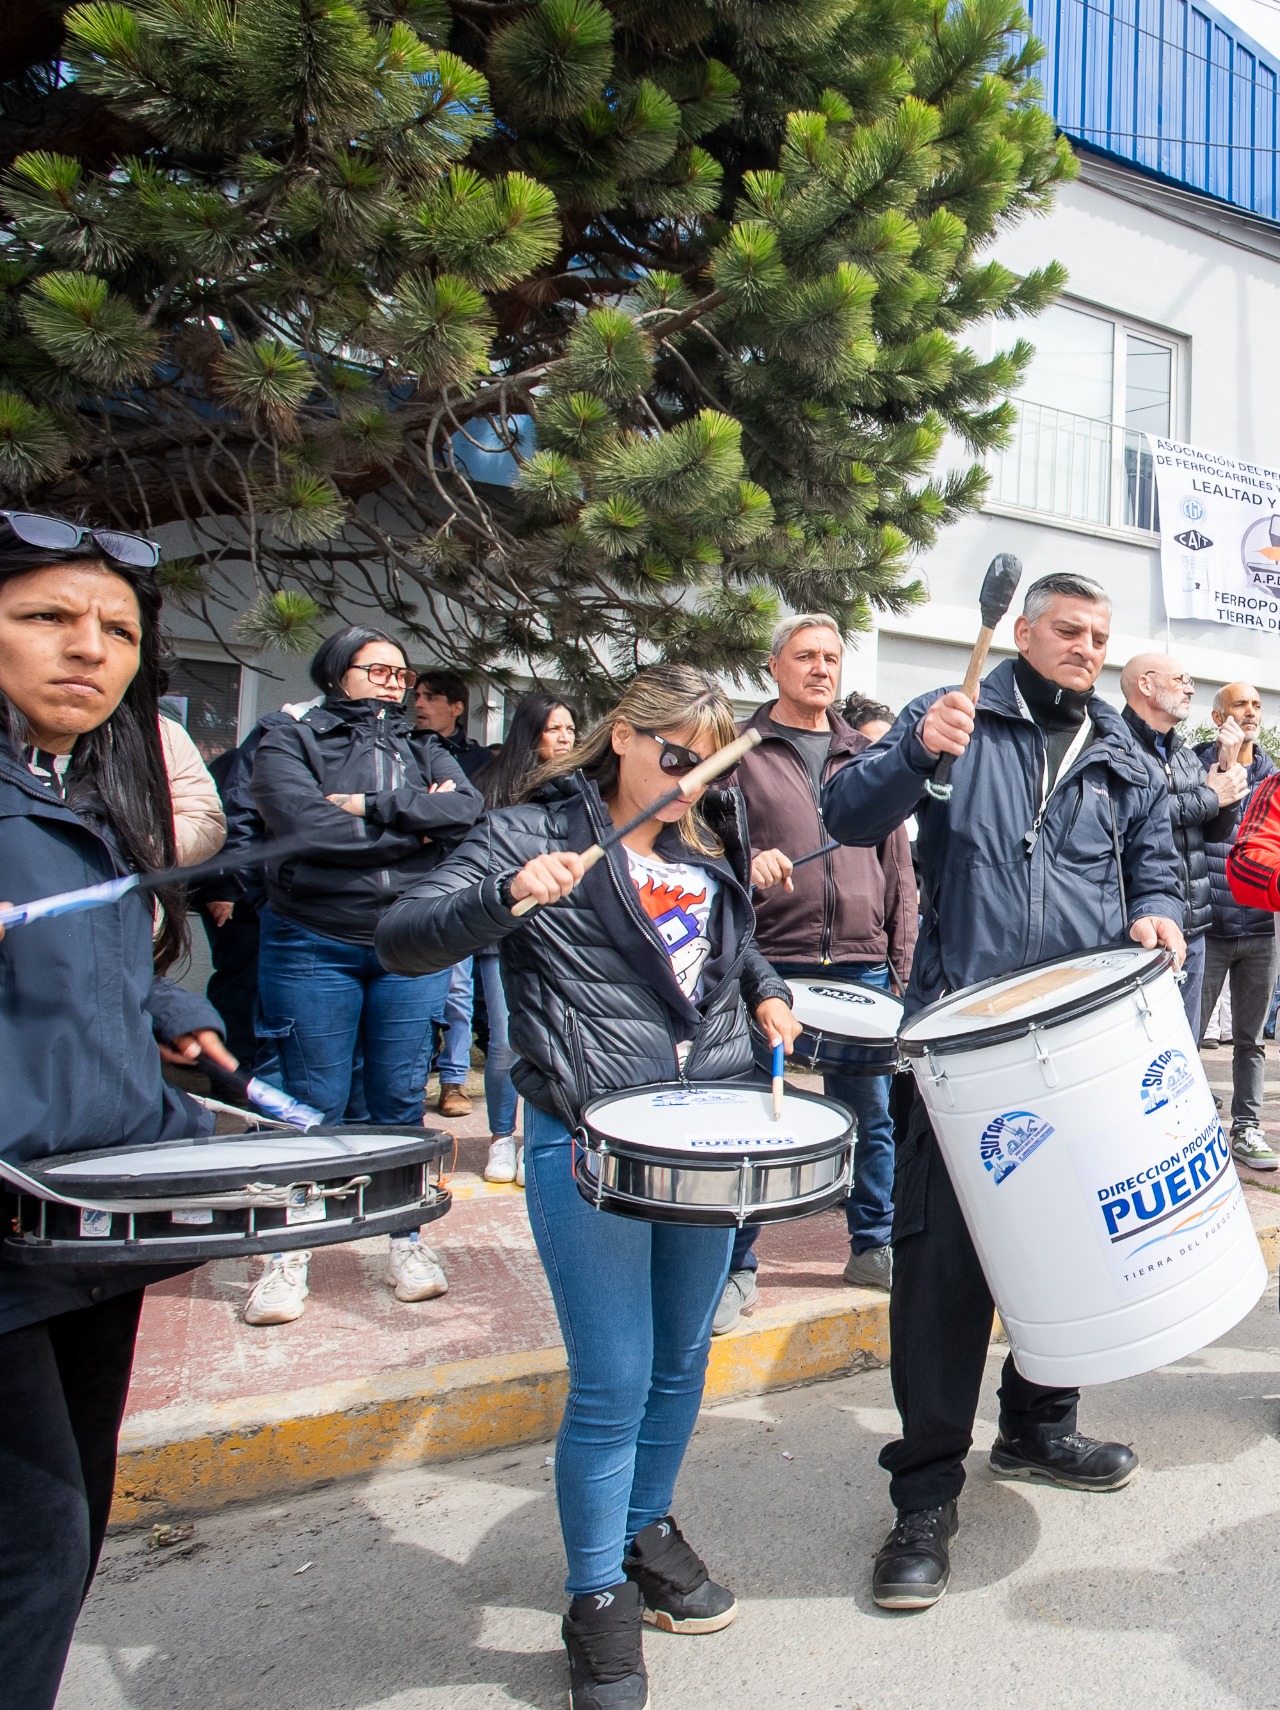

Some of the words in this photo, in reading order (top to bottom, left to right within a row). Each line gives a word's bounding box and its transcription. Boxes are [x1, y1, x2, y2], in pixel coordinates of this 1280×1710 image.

[1157, 439, 1235, 469] ASOCIACIÓN
[1238, 462, 1261, 476] DEL
[1157, 455, 1173, 466] DE
[1175, 458, 1273, 491] FERROCARRILES
[1192, 478, 1263, 506] LEALTAD
[1267, 496, 1276, 509] Y
[1216, 608, 1263, 627] TIERRA
[1142, 1050, 1172, 1087] SUTAP
[691, 1139, 794, 1147] PUERTOS
[980, 1117, 1005, 1160] SUTAP
[1097, 1152, 1181, 1202] DIRECCION
[1182, 1114, 1220, 1159] PROVINC
[1101, 1125, 1229, 1236] PUERTO
[1124, 1256, 1173, 1282] TIERRA
[1179, 1240, 1200, 1256] DEL
